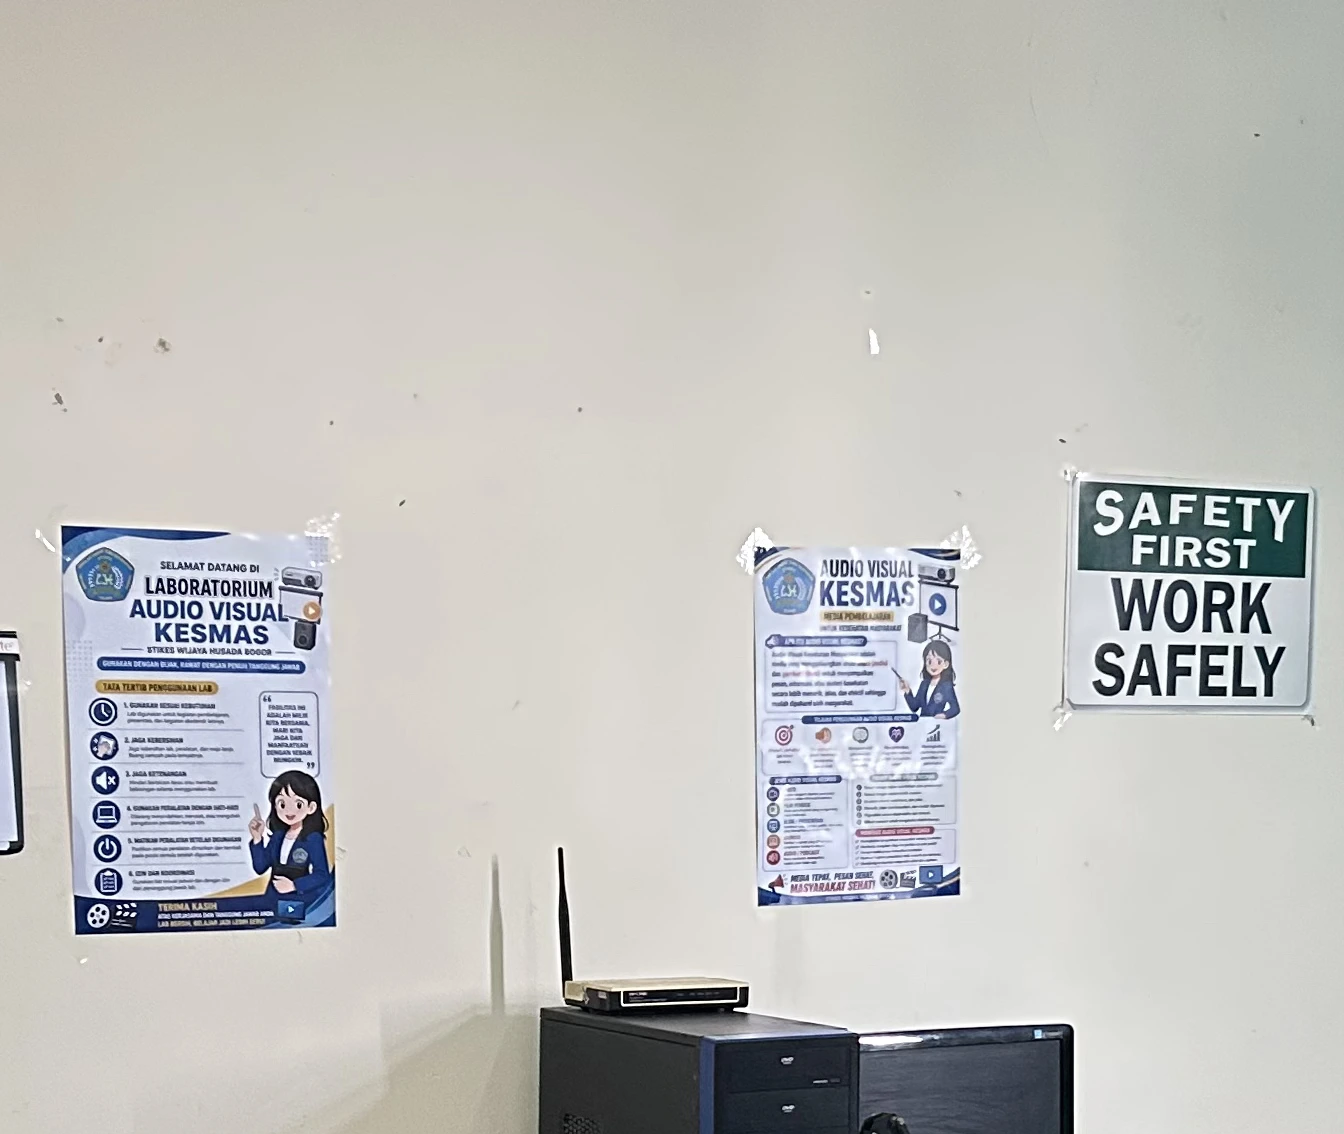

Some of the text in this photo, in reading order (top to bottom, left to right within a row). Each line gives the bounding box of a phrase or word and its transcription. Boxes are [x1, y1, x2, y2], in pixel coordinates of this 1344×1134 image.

[1093, 489, 1295, 543] SAFETY
[1131, 534, 1256, 570] FIRST
[160, 561, 260, 573] SELAMAT DATANG DI
[820, 559, 914, 578] AUDIO VISUAL
[145, 577, 273, 598] LABORATORIUM
[820, 580, 914, 607] KESMAS
[129, 599, 289, 622] AUDIO VISUAL
[1111, 577, 1272, 634] WORK
[155, 622, 270, 645] KESMAS
[1092, 642, 1286, 698] SAFELY
